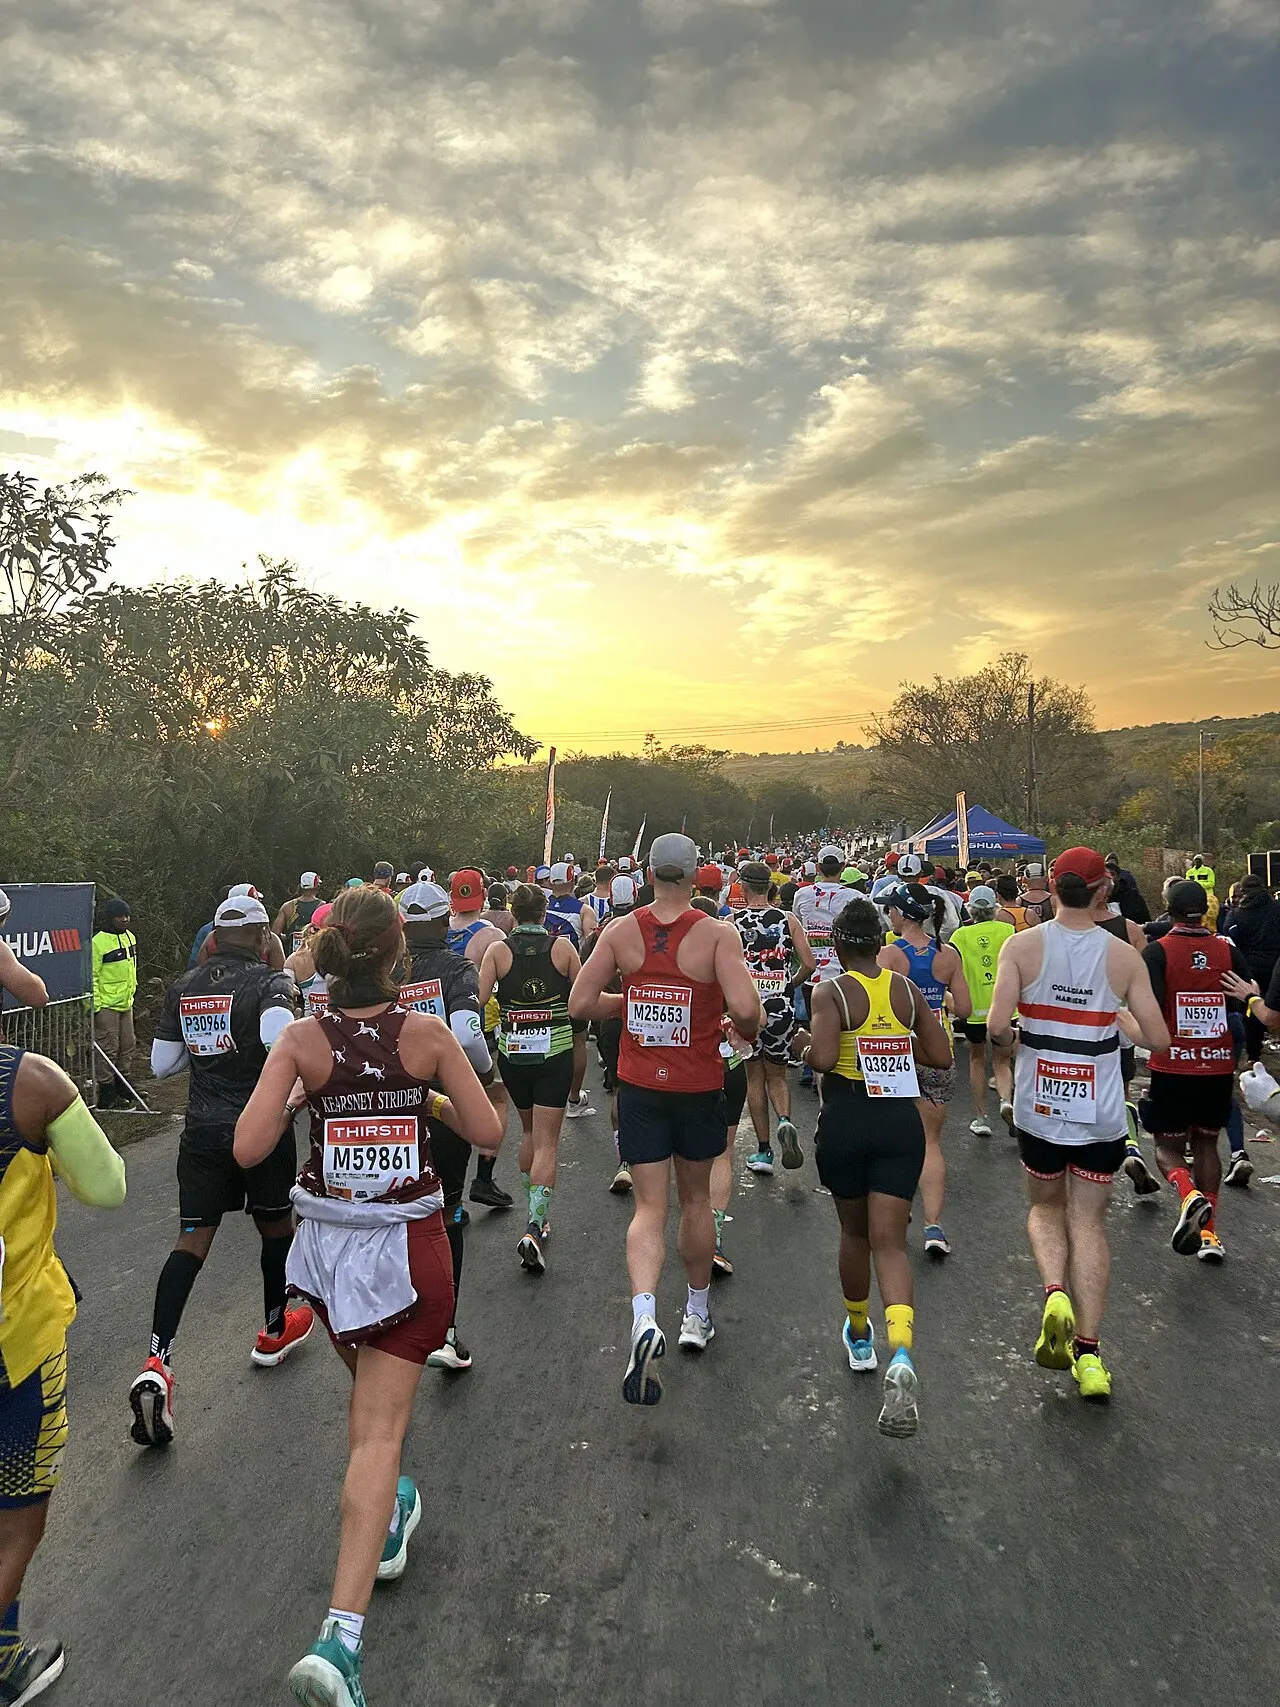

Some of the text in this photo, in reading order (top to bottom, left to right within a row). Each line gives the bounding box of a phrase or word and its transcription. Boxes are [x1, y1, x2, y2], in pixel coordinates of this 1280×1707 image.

[5, 931, 53, 957] HUA
[400, 985, 436, 1000] HIRSTI
[757, 980, 781, 991] 16497
[634, 989, 685, 1001] THIRSTI
[183, 1000, 226, 1010] THIRSTI
[634, 1003, 683, 1023] M25653
[1185, 1007, 1219, 1020] N5967
[185, 1014, 226, 1032] P30966
[1211, 1023, 1226, 1035] 40
[216, 1034, 232, 1050] 40
[671, 1026, 688, 1044] 40
[861, 1042, 908, 1050] THIRSTI
[1200, 1046, 1231, 1060] Cats
[864, 1056, 911, 1073] Q38246
[1040, 1063, 1091, 1077] THIRSTI
[1042, 1078, 1087, 1098] M7273
[321, 1086, 423, 1113] KEARSNEY STRIDERS
[333, 1125, 410, 1138] THIRSTI
[333, 1146, 411, 1171] M59861
